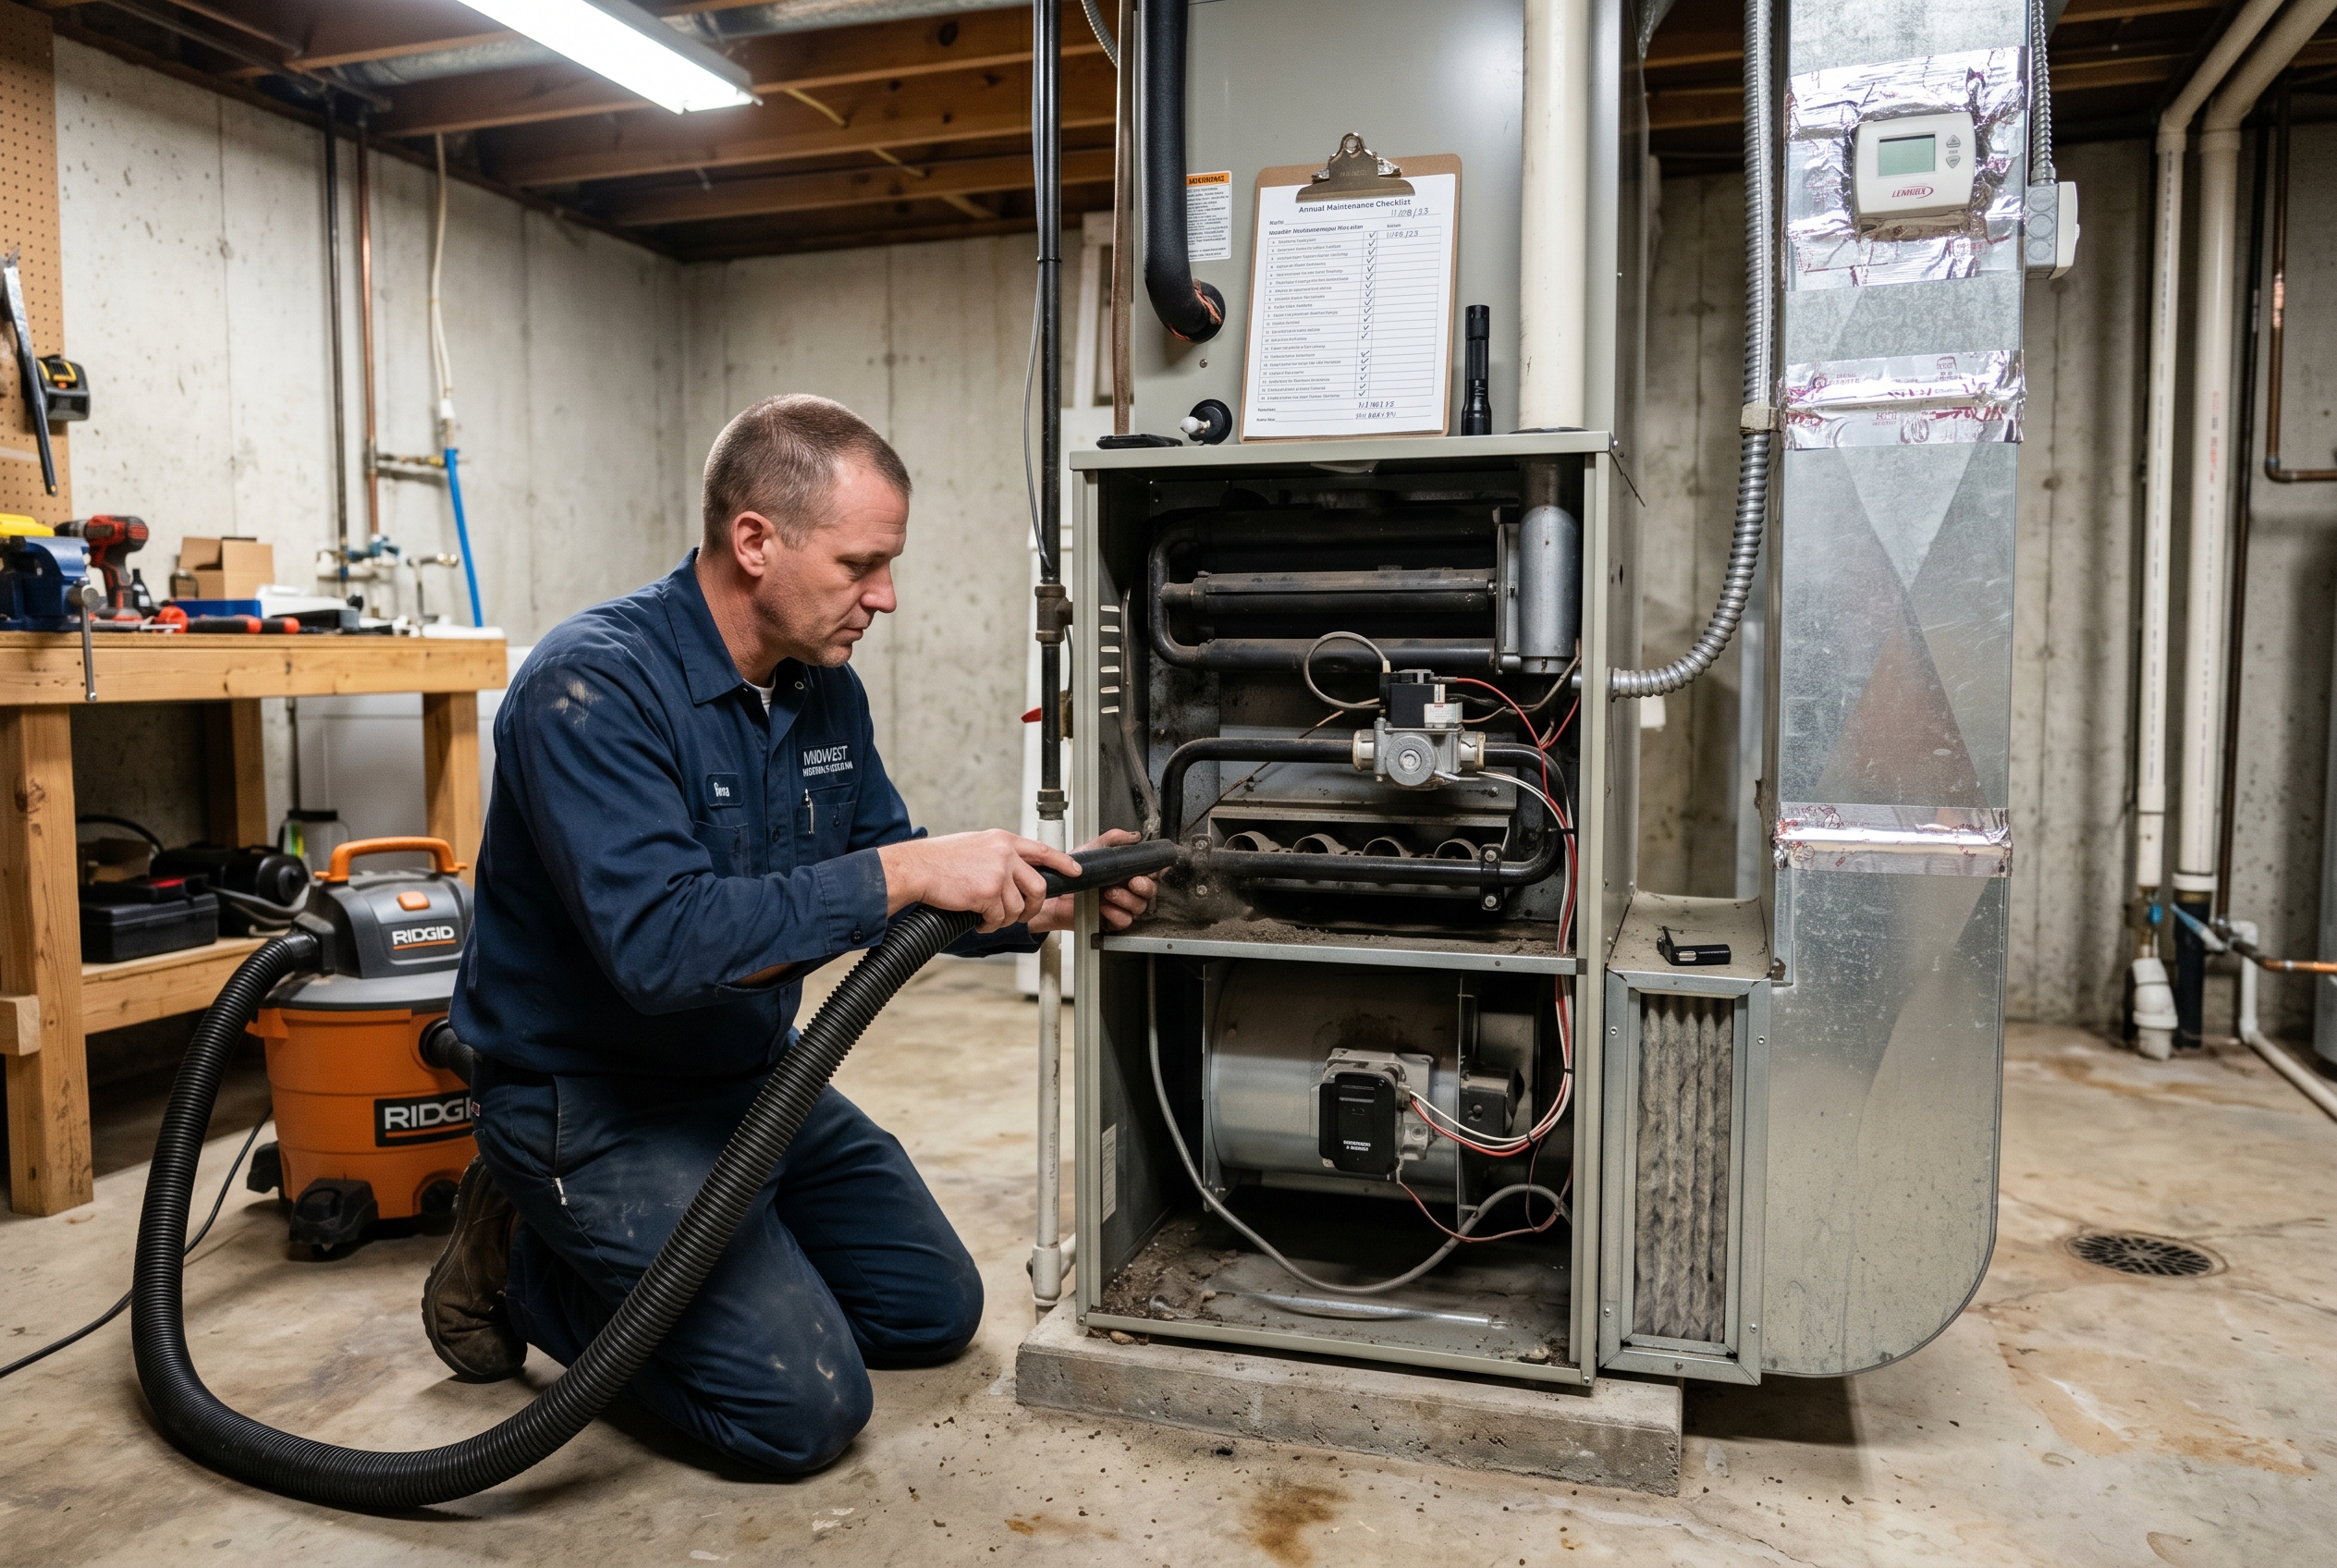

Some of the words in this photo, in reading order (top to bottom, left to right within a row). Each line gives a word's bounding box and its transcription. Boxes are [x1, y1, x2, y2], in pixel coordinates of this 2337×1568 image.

[1298, 204, 1325, 214] Annual
[1327, 201, 1375, 212] Maintenance
[391, 925, 455, 946] RIDGID
[385, 1098, 471, 1130] RIDGI
